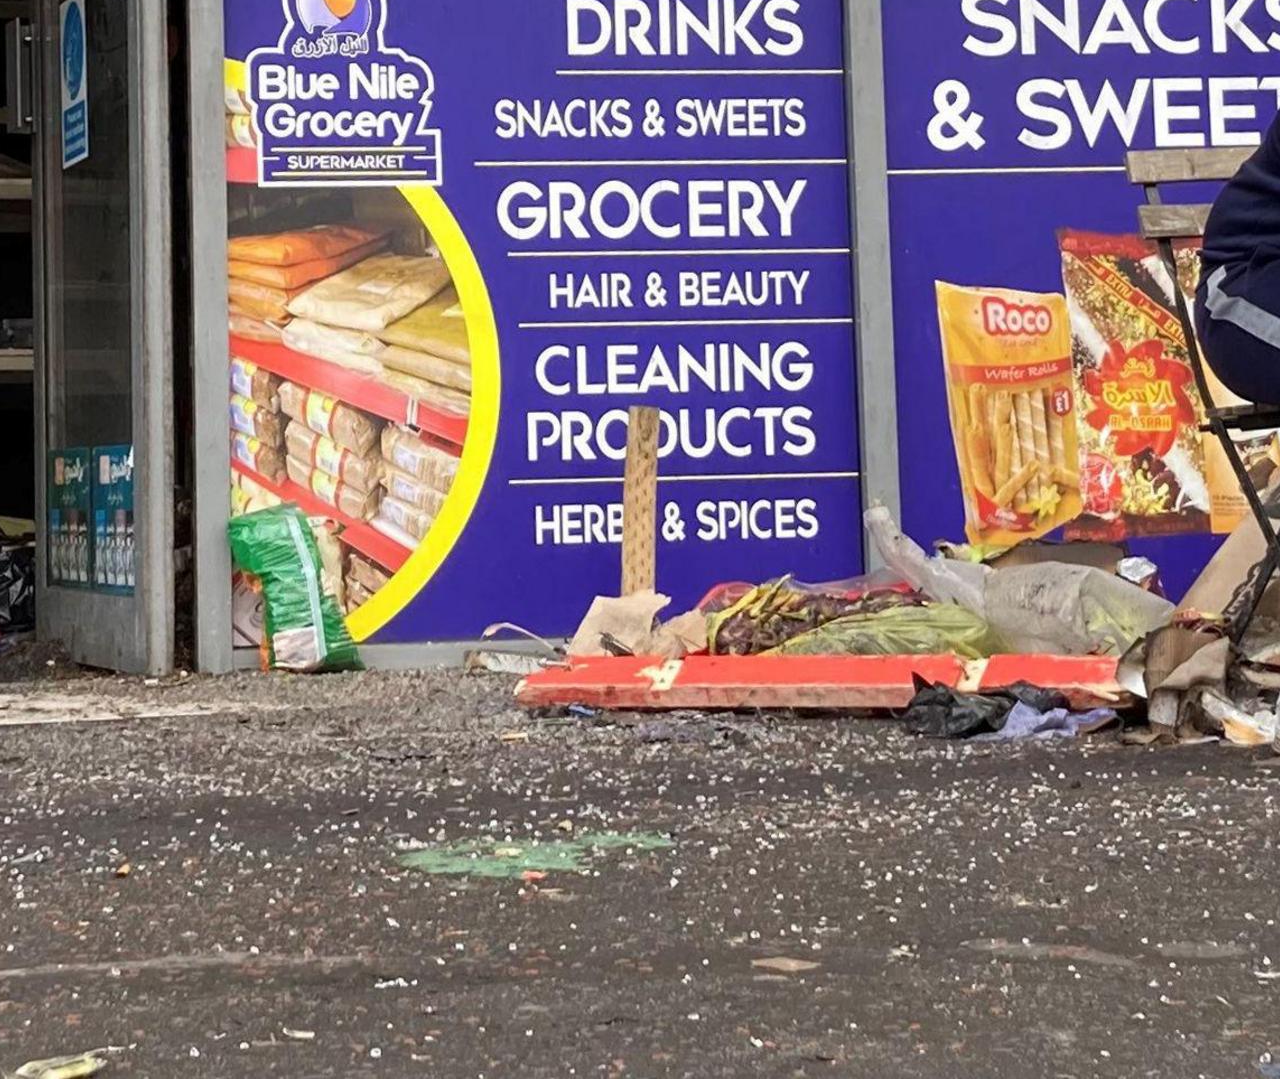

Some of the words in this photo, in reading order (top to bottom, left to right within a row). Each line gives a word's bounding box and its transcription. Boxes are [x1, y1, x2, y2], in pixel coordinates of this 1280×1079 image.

[258, 62, 340, 101] Blue
[349, 62, 420, 101] Nile
[264, 102, 415, 146] Grocery
[494, 98, 633, 139] SNACKS
[642, 98, 666, 138] &
[675, 97, 807, 138] SWEETS
[926, 78, 986, 152] &
[287, 154, 406, 170] SUPERMARKET
[496, 179, 808, 240] GROCERY
[549, 272, 634, 309] HAIR
[644, 272, 668, 308] &
[678, 269, 810, 307] BEAUTY
[535, 341, 814, 396] CLEANING
[535, 503, 625, 545] HERB
[661, 501, 686, 541] &
[696, 498, 819, 541] SPICES
